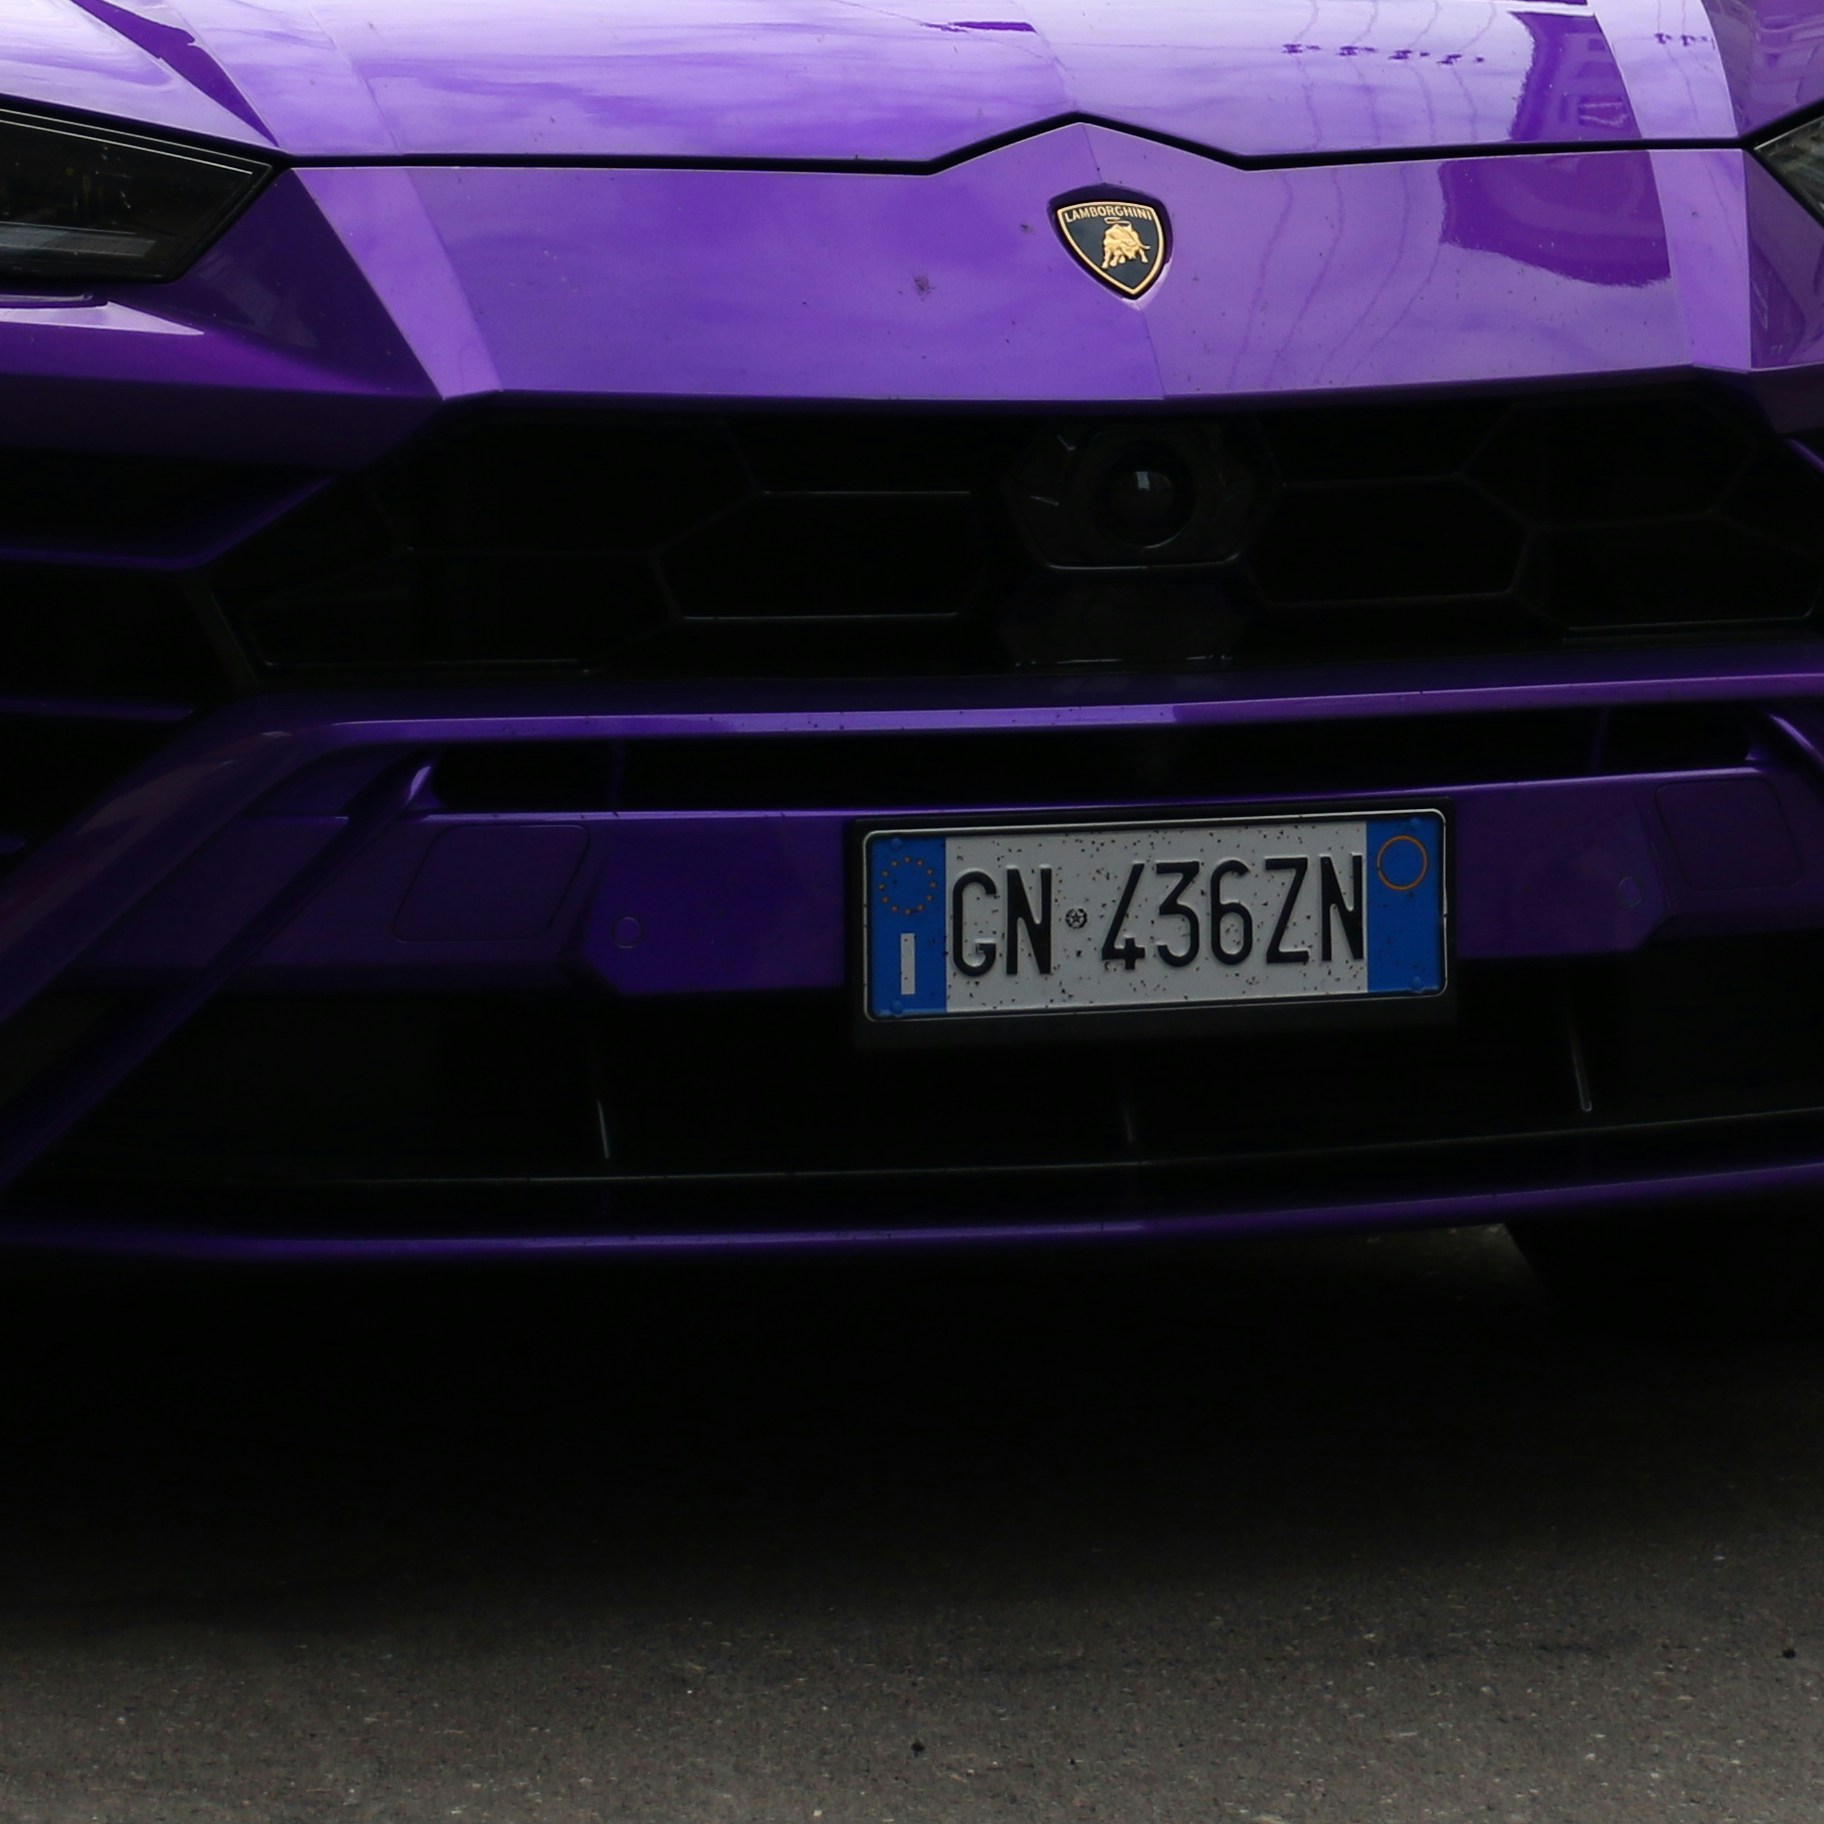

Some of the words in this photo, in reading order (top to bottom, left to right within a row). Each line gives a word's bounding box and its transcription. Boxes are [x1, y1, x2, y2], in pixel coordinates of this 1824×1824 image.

[1064, 205, 1153, 222] LAMBORGHINI
[952, 867, 1053, 977] GN
[1101, 853, 1365, 971] 436ZN
